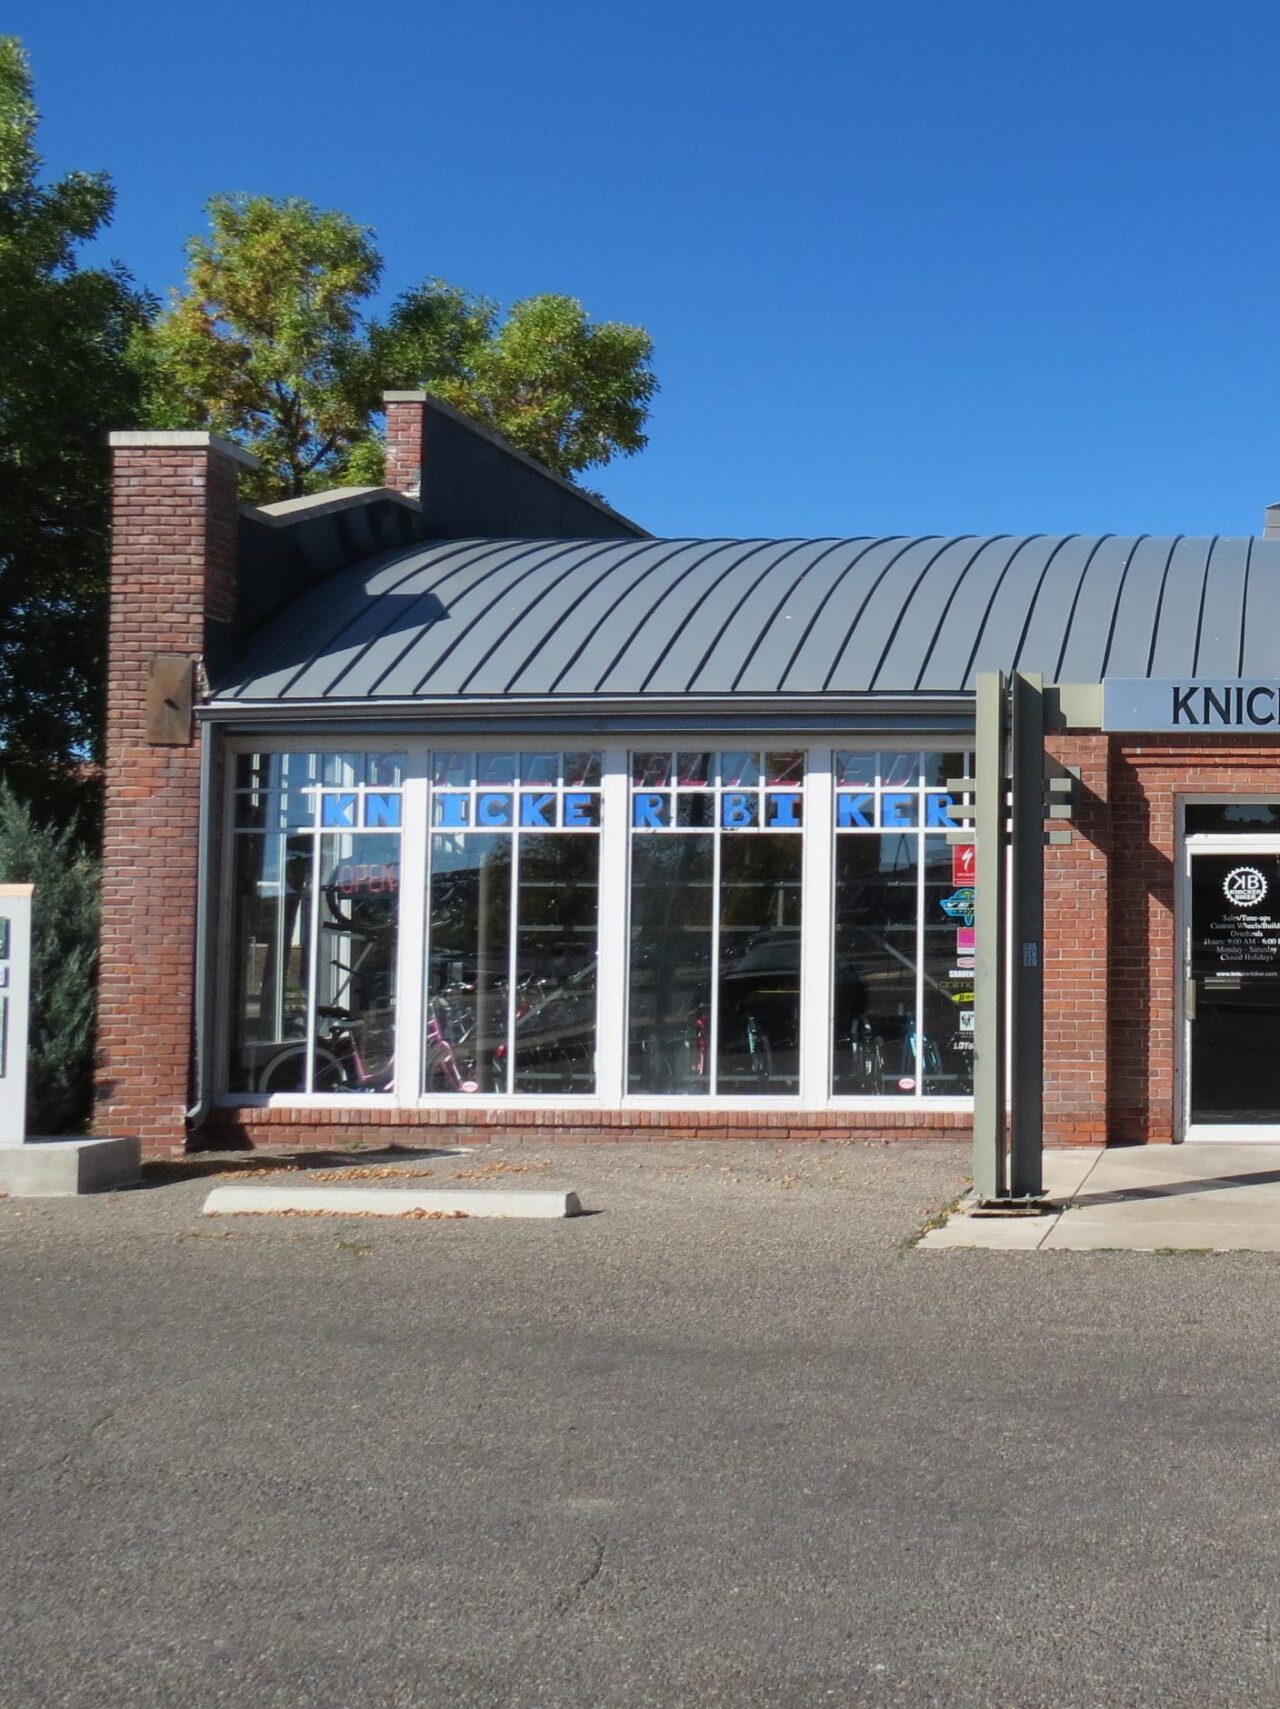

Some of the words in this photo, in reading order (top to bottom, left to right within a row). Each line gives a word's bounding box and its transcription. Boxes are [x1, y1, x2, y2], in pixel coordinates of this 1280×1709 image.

[321, 793, 665, 828] KNICKER
[339, 863, 399, 895] OPEN
[1222, 914, 1271, 923] Sales/Tune-ups
[1249, 946, 1278, 954] Saturday
[1244, 954, 1274, 962] Holidays
